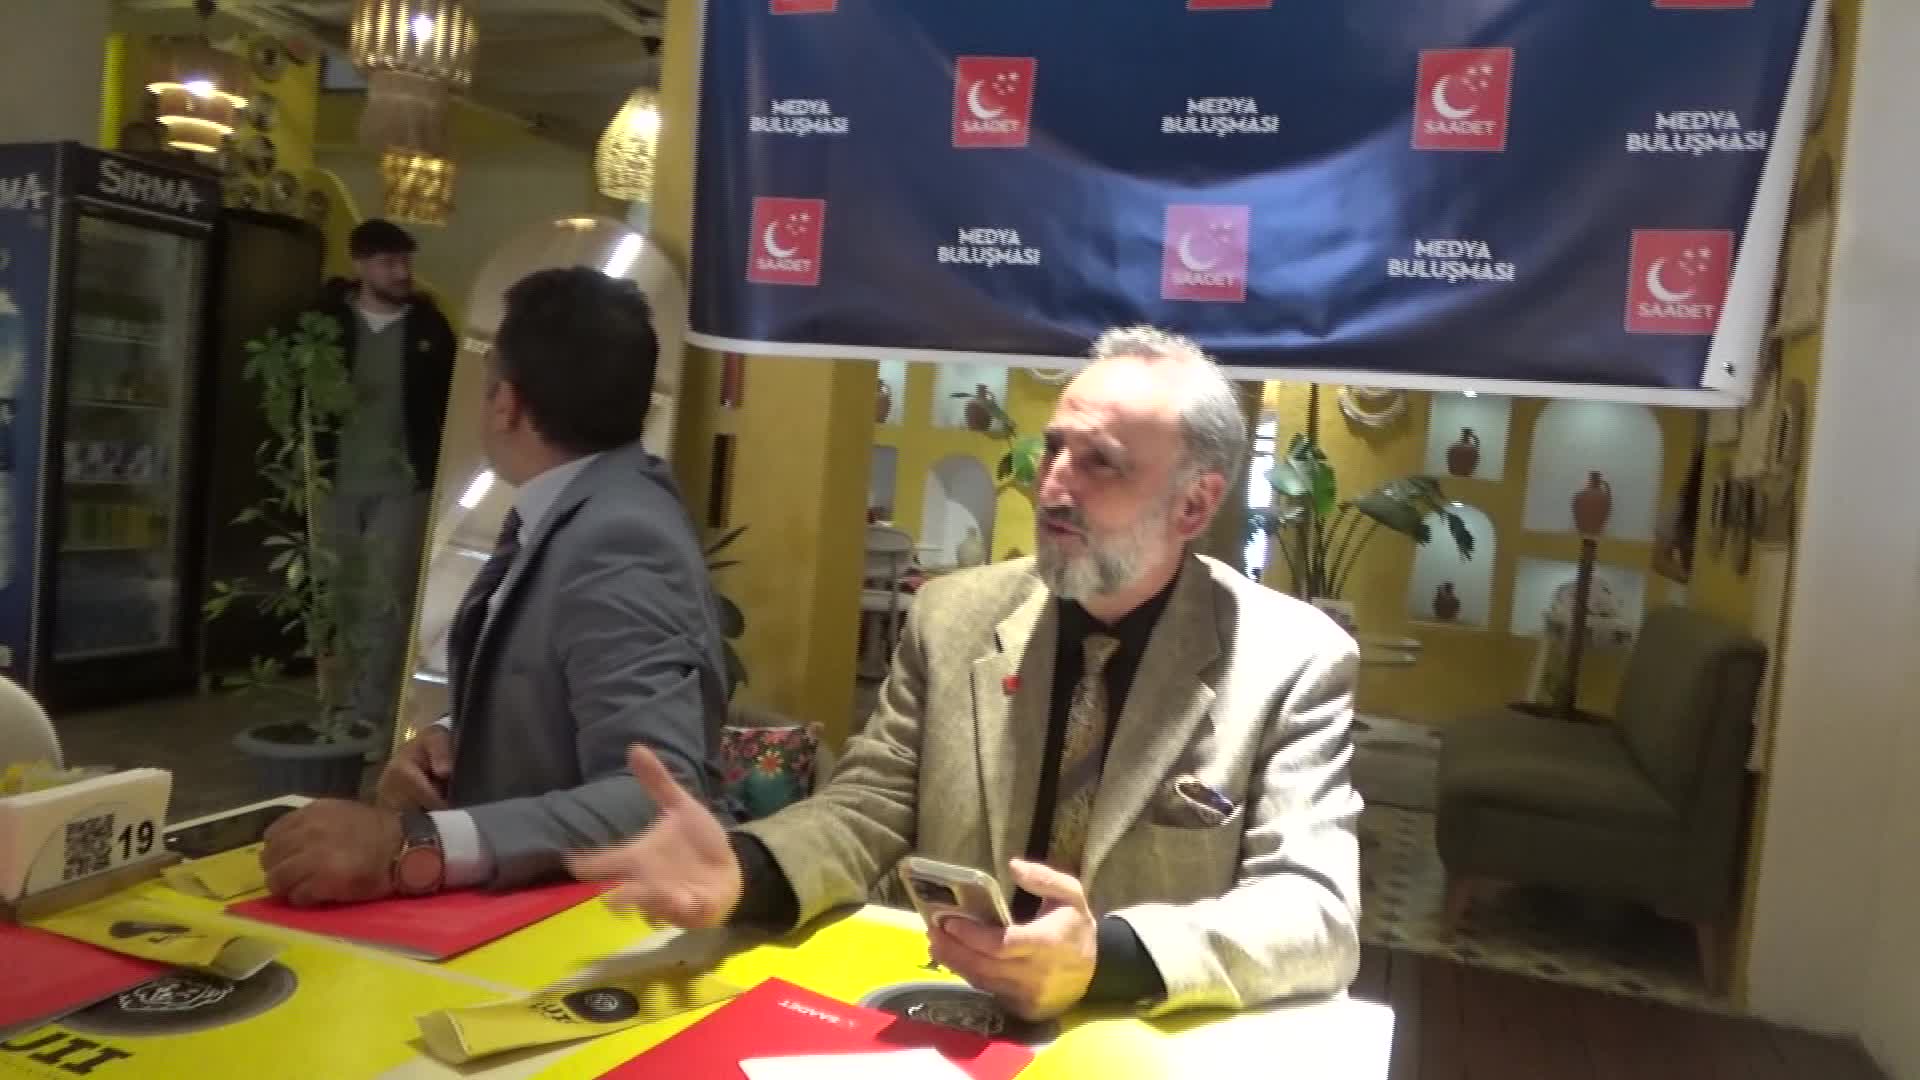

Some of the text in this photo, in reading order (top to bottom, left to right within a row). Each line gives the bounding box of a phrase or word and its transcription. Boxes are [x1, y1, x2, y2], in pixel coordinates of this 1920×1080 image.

[771, 99, 831, 115] MEDYA
[1187, 97, 1257, 114] MEDYA
[749, 116, 848, 135] BULUŞMASI
[963, 119, 1020, 133] SAADET
[1161, 116, 1279, 136] BULUŞMASI
[1423, 120, 1496, 136] SAADET
[1655, 110, 1741, 130] MEDYA
[1626, 131, 1767, 155] BULUŞMASI
[98, 159, 203, 212] SIRMA
[957, 227, 1020, 246] MEDYA
[936, 245, 1041, 267] BULUŞMASI
[1414, 239, 1491, 260] MEDYA
[757, 258, 810, 272] SAADET
[1387, 258, 1515, 284] BULUŞMASI
[1173, 273, 1235, 287] SAADET
[1638, 302, 1714, 319] SAADET
[118, 821, 154, 860] 19
